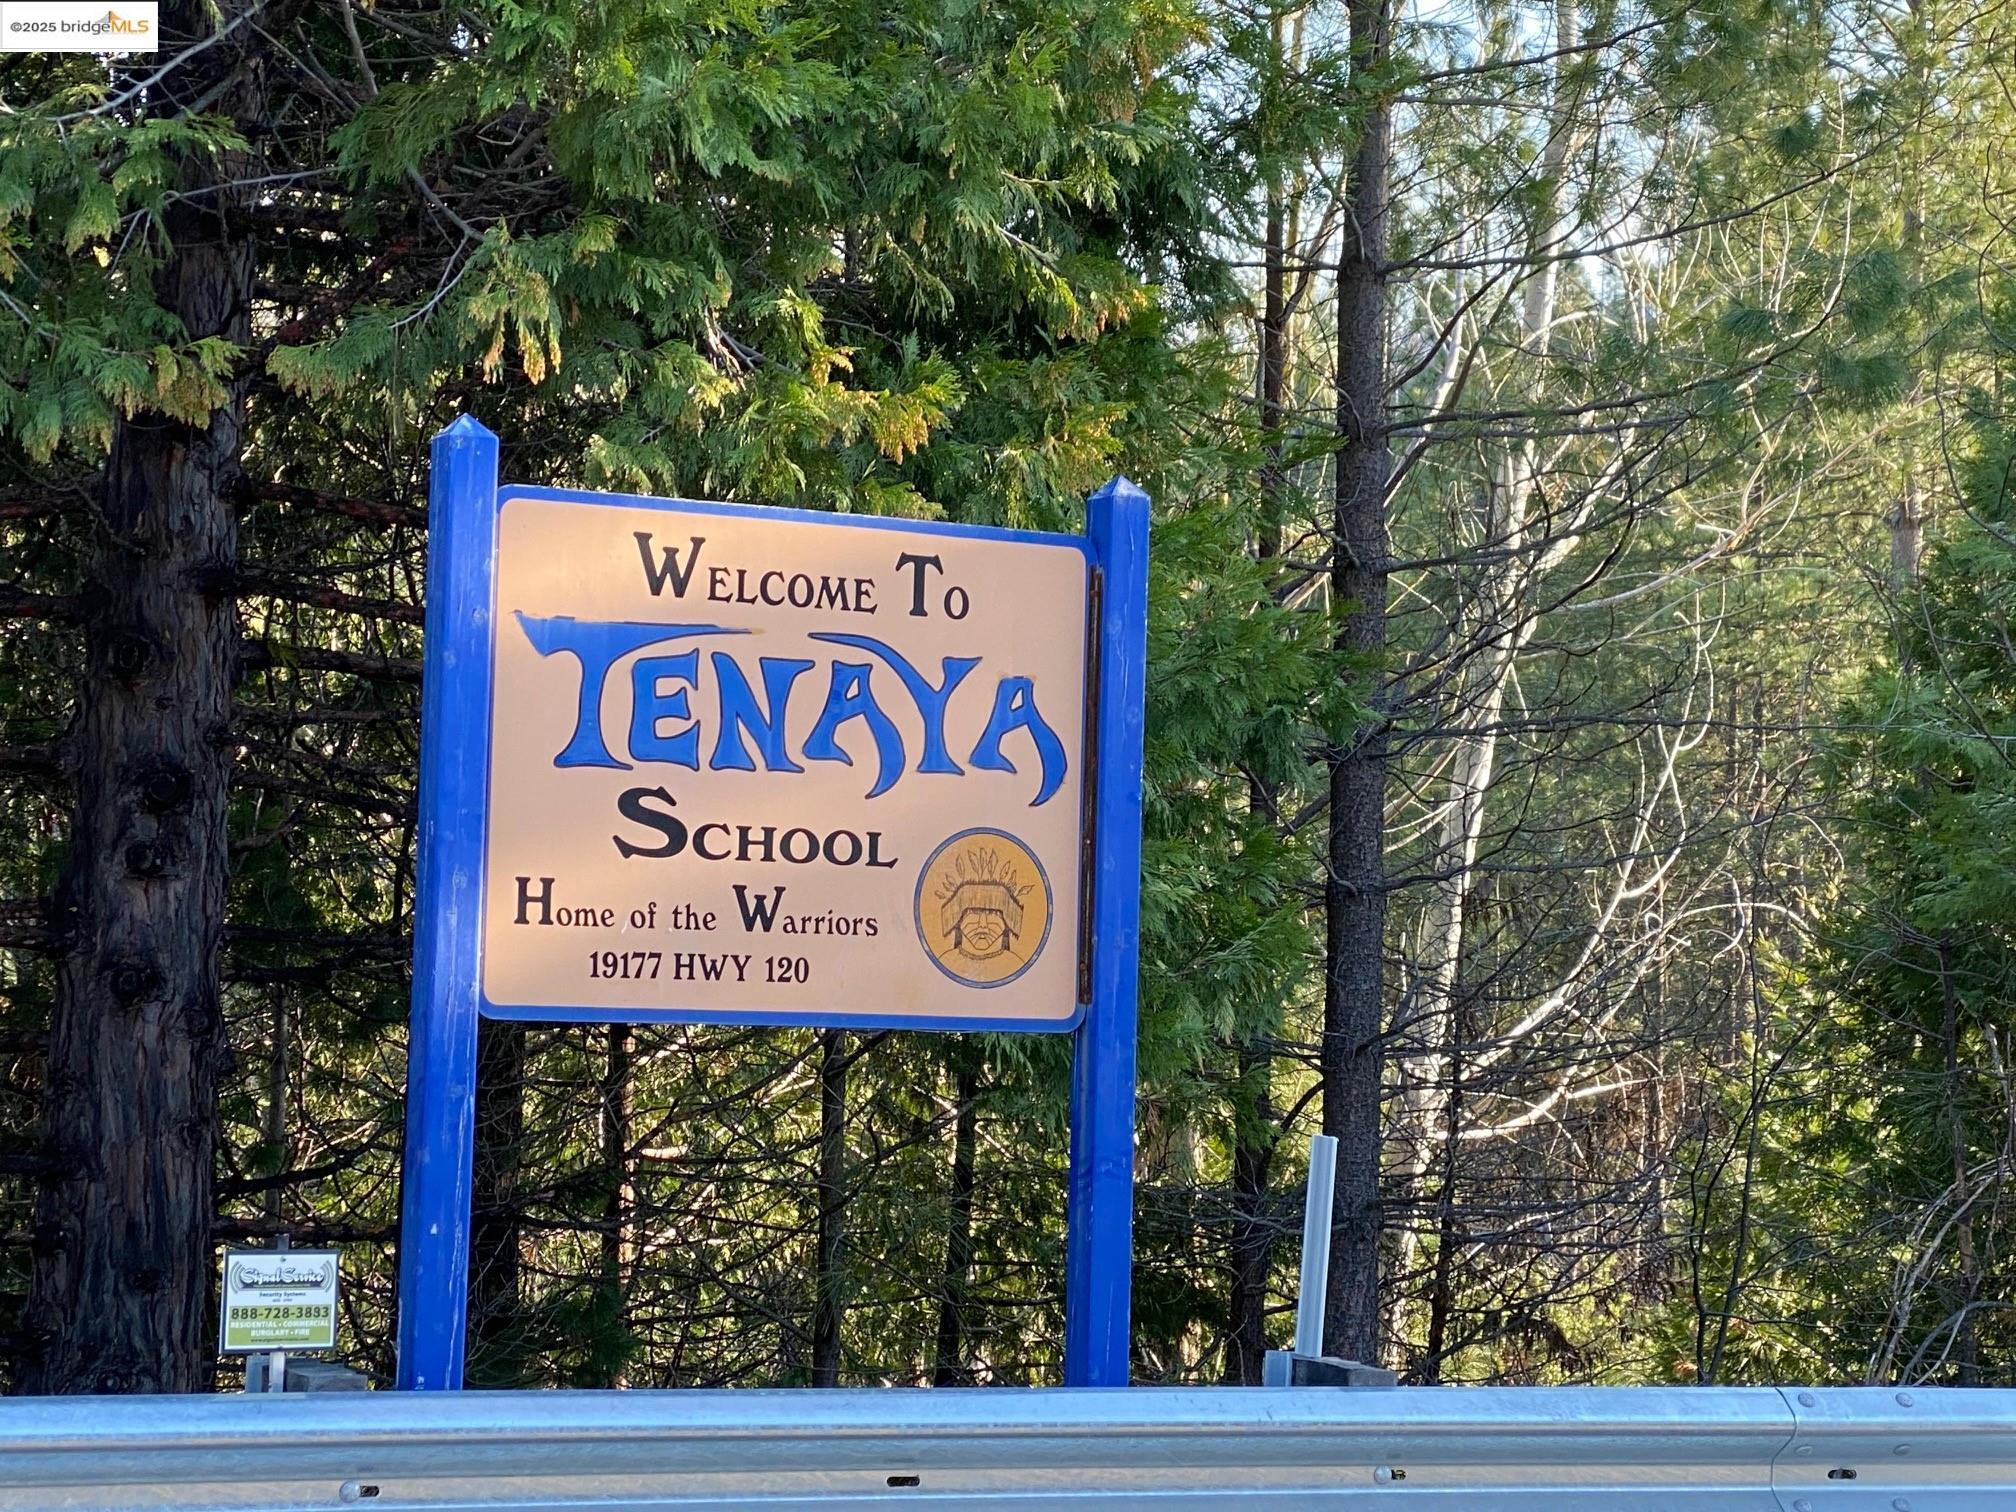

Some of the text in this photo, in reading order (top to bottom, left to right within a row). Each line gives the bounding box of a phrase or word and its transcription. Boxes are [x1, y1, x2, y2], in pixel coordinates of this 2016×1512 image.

[633, 531, 878, 614] WELCOME
[510, 609, 1068, 807] TENAYA
[612, 786, 898, 868] SCHOOL
[513, 876, 880, 938] Home of the Warriors
[588, 951, 810, 984] 19177 HWY 120
